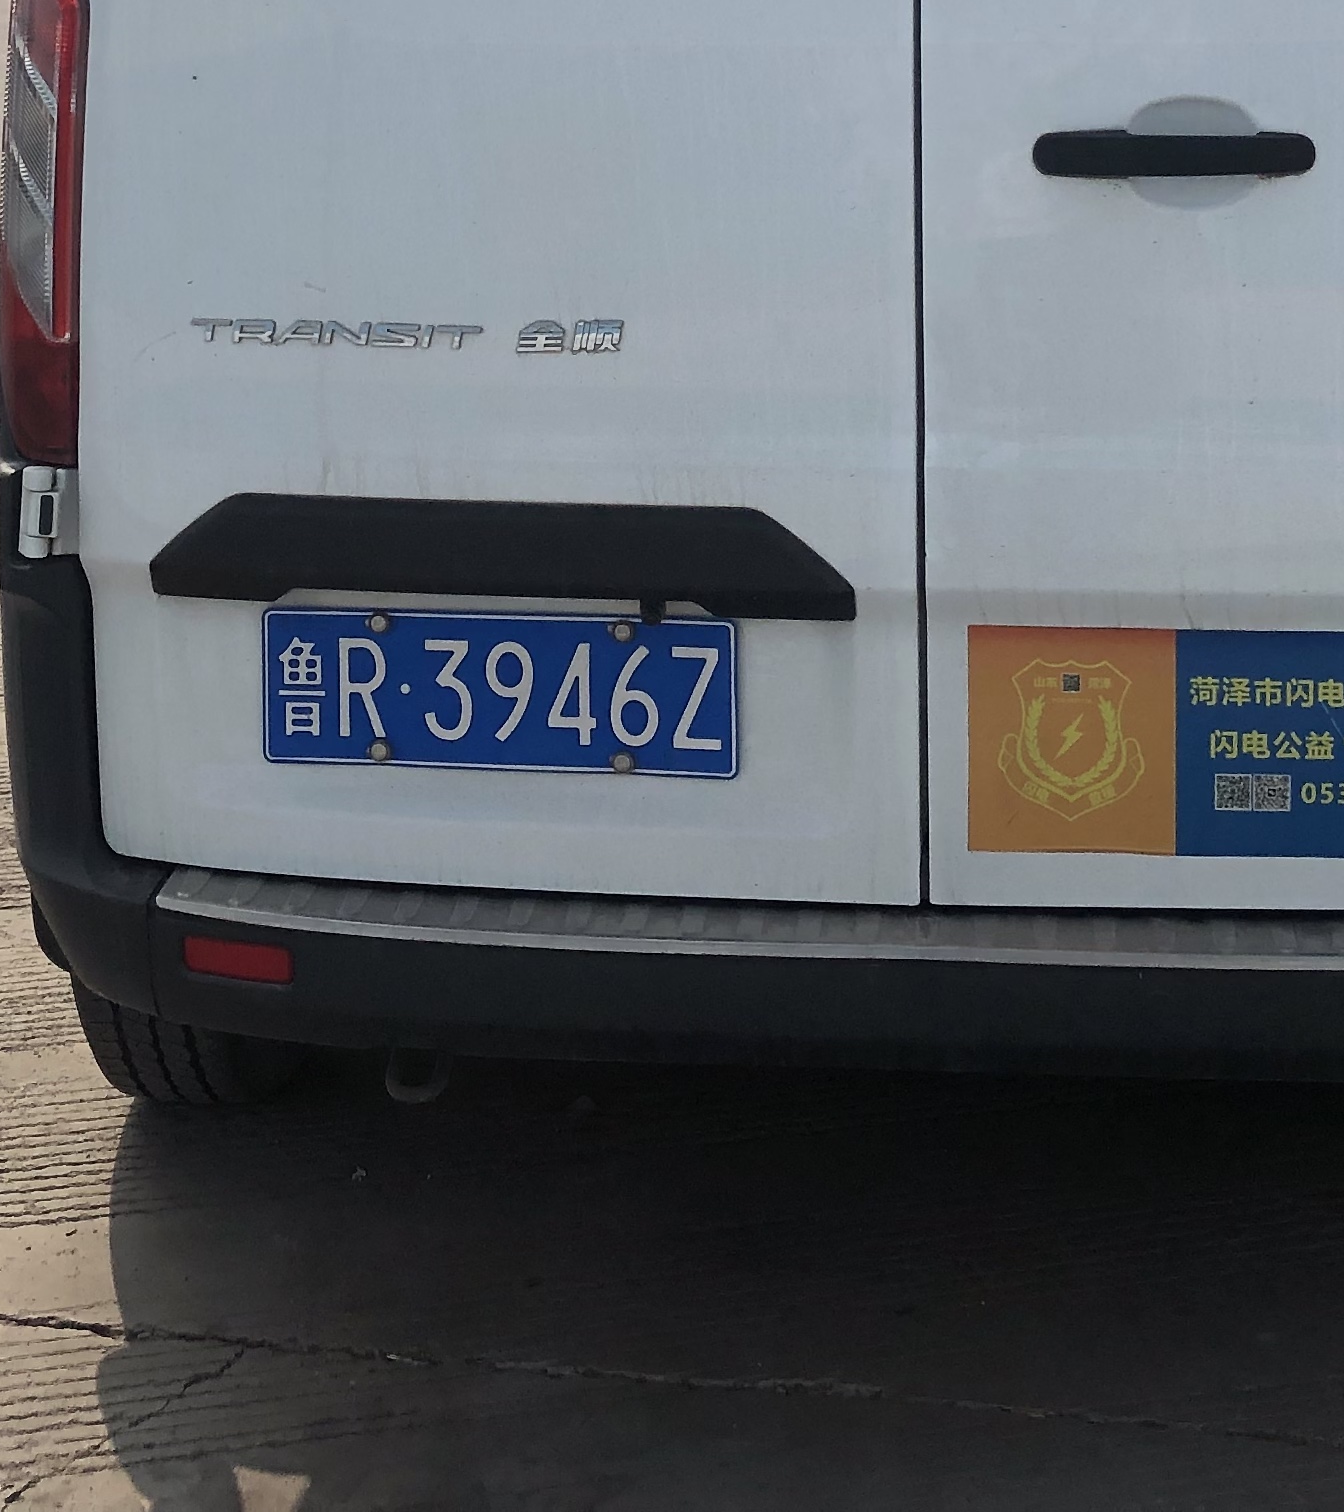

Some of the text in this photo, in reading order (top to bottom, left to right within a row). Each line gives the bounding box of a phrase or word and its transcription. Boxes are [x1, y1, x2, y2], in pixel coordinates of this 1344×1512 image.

[190, 317, 625, 354] TRANSIT 全顺
[277, 636, 723, 752] 鲁R·3946Z
[1209, 728, 1335, 761] 闪电公益
